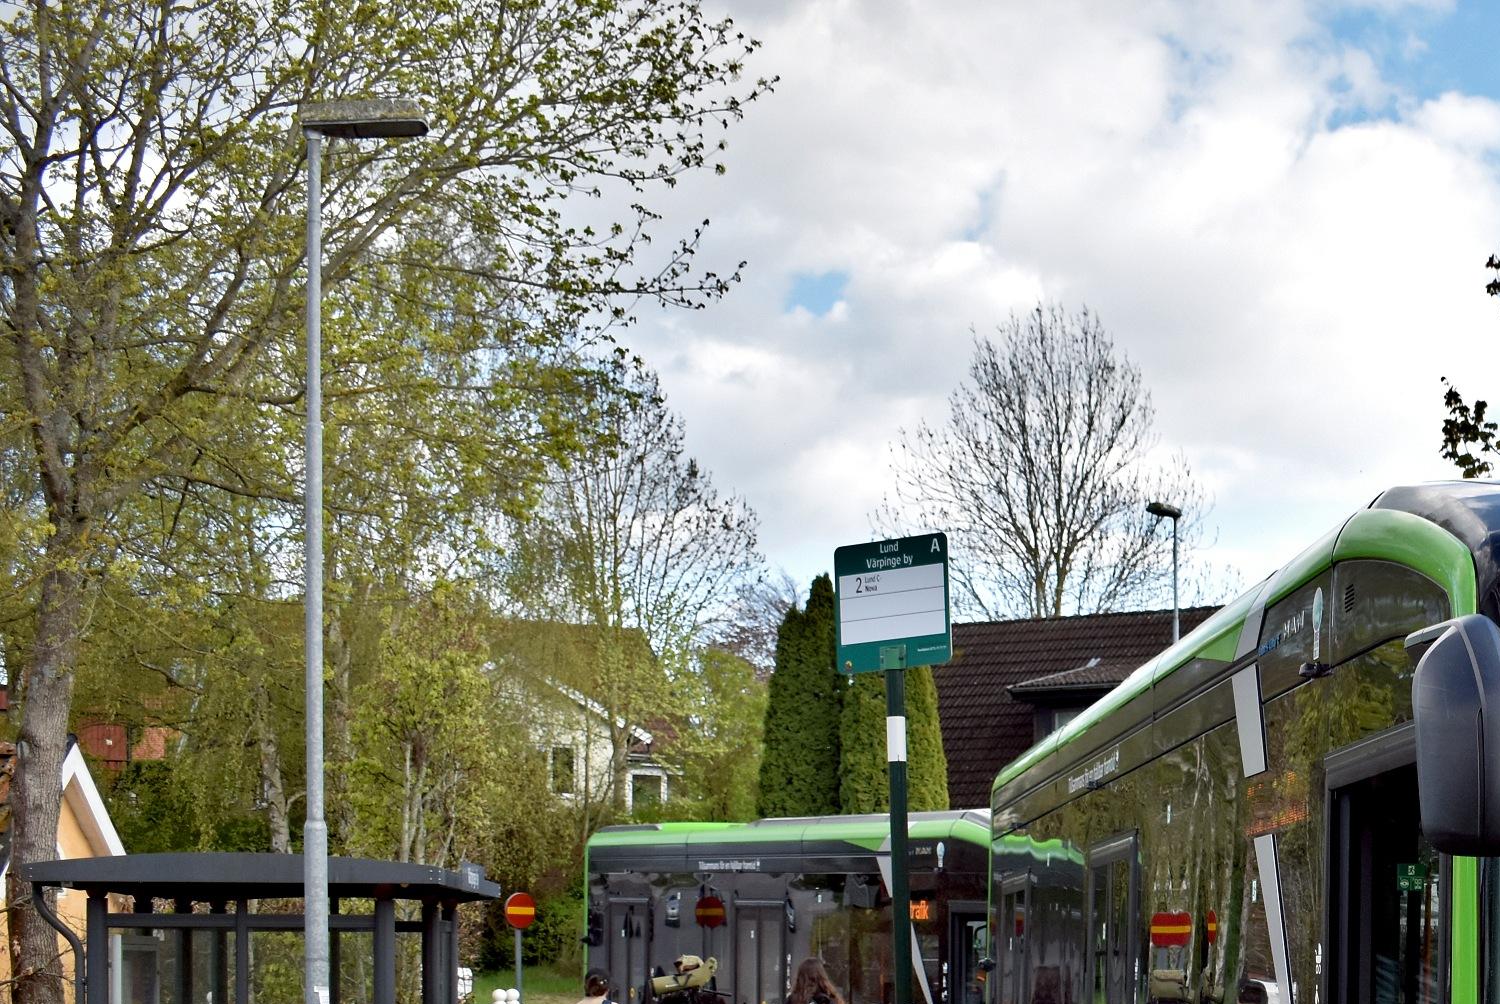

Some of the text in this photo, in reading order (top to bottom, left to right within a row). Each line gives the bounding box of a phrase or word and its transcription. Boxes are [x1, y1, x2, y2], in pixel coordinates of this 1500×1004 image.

[880, 541, 899, 553] Lund
[931, 538, 940, 552] A
[866, 553, 913, 569] Värpinge by
[856, 577, 862, 593] 2
